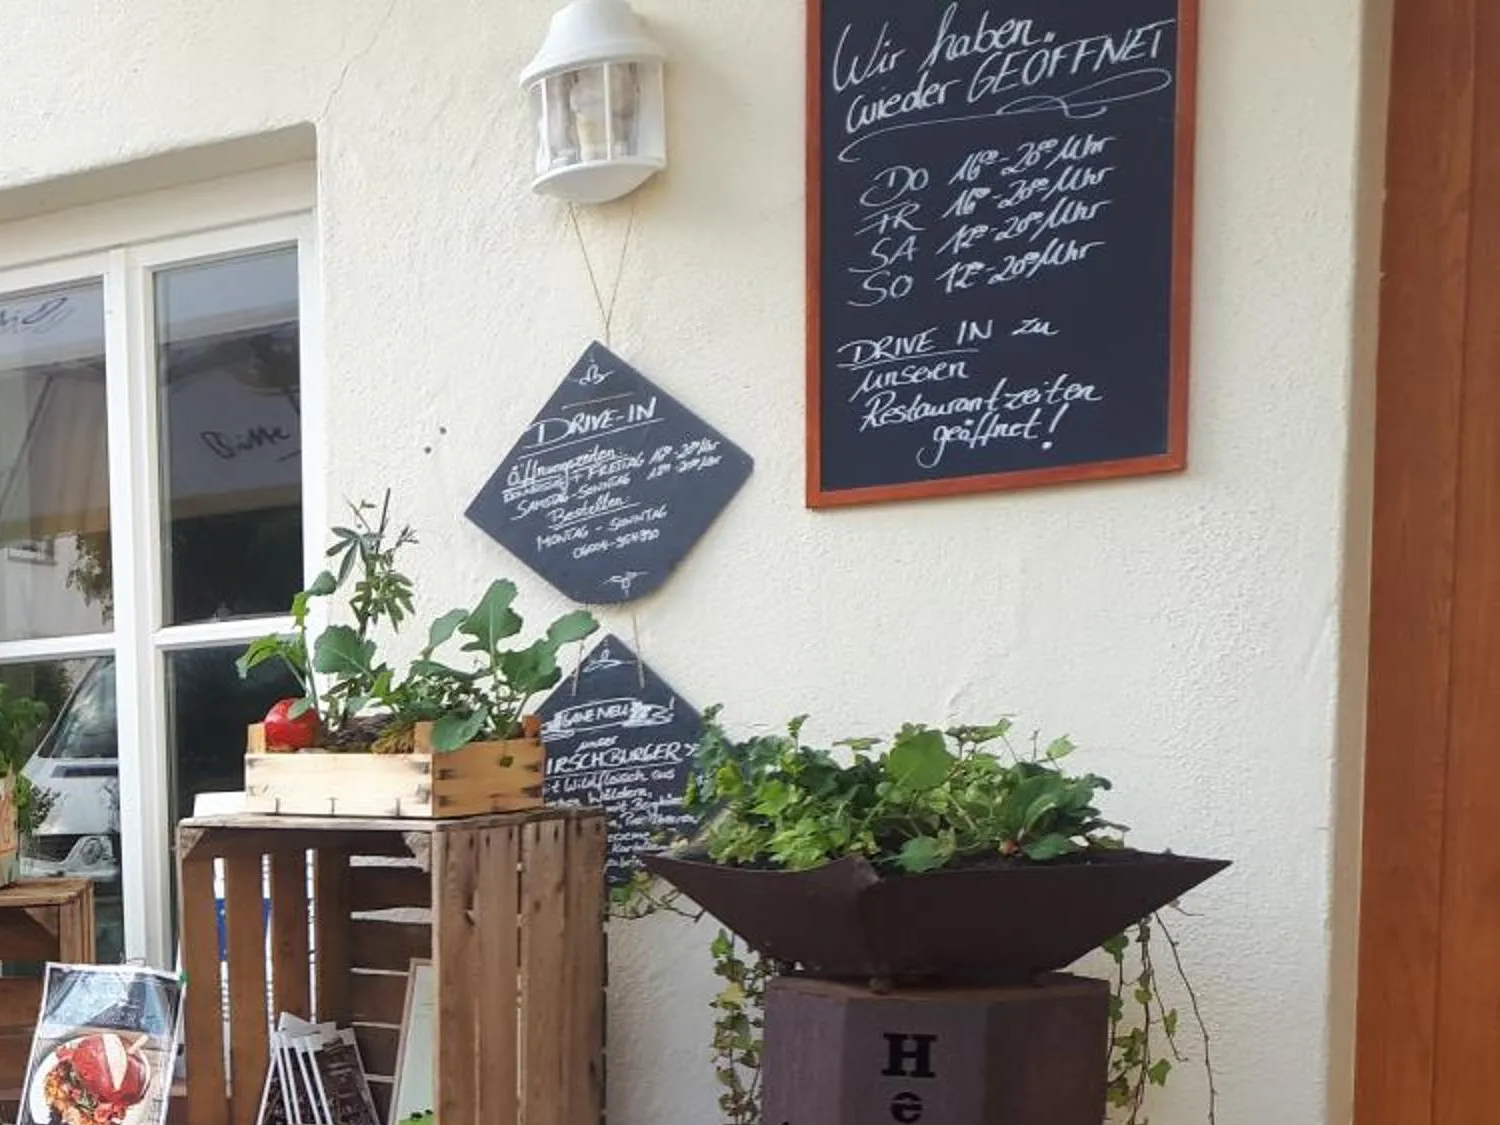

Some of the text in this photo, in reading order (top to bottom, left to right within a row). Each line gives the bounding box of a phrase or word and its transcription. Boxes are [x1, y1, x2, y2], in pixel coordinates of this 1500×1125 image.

[833, 2, 1041, 93] Wir haben
[846, 72, 962, 133] wieder
[860, 165, 928, 206] DO
[848, 234, 920, 272] SA
[848, 271, 913, 307] SO
[837, 317, 1059, 365] DRIVE IN zu
[524, 396, 657, 449] DRIVE-IN
[546, 742, 684, 775] IRSCHBURGER
